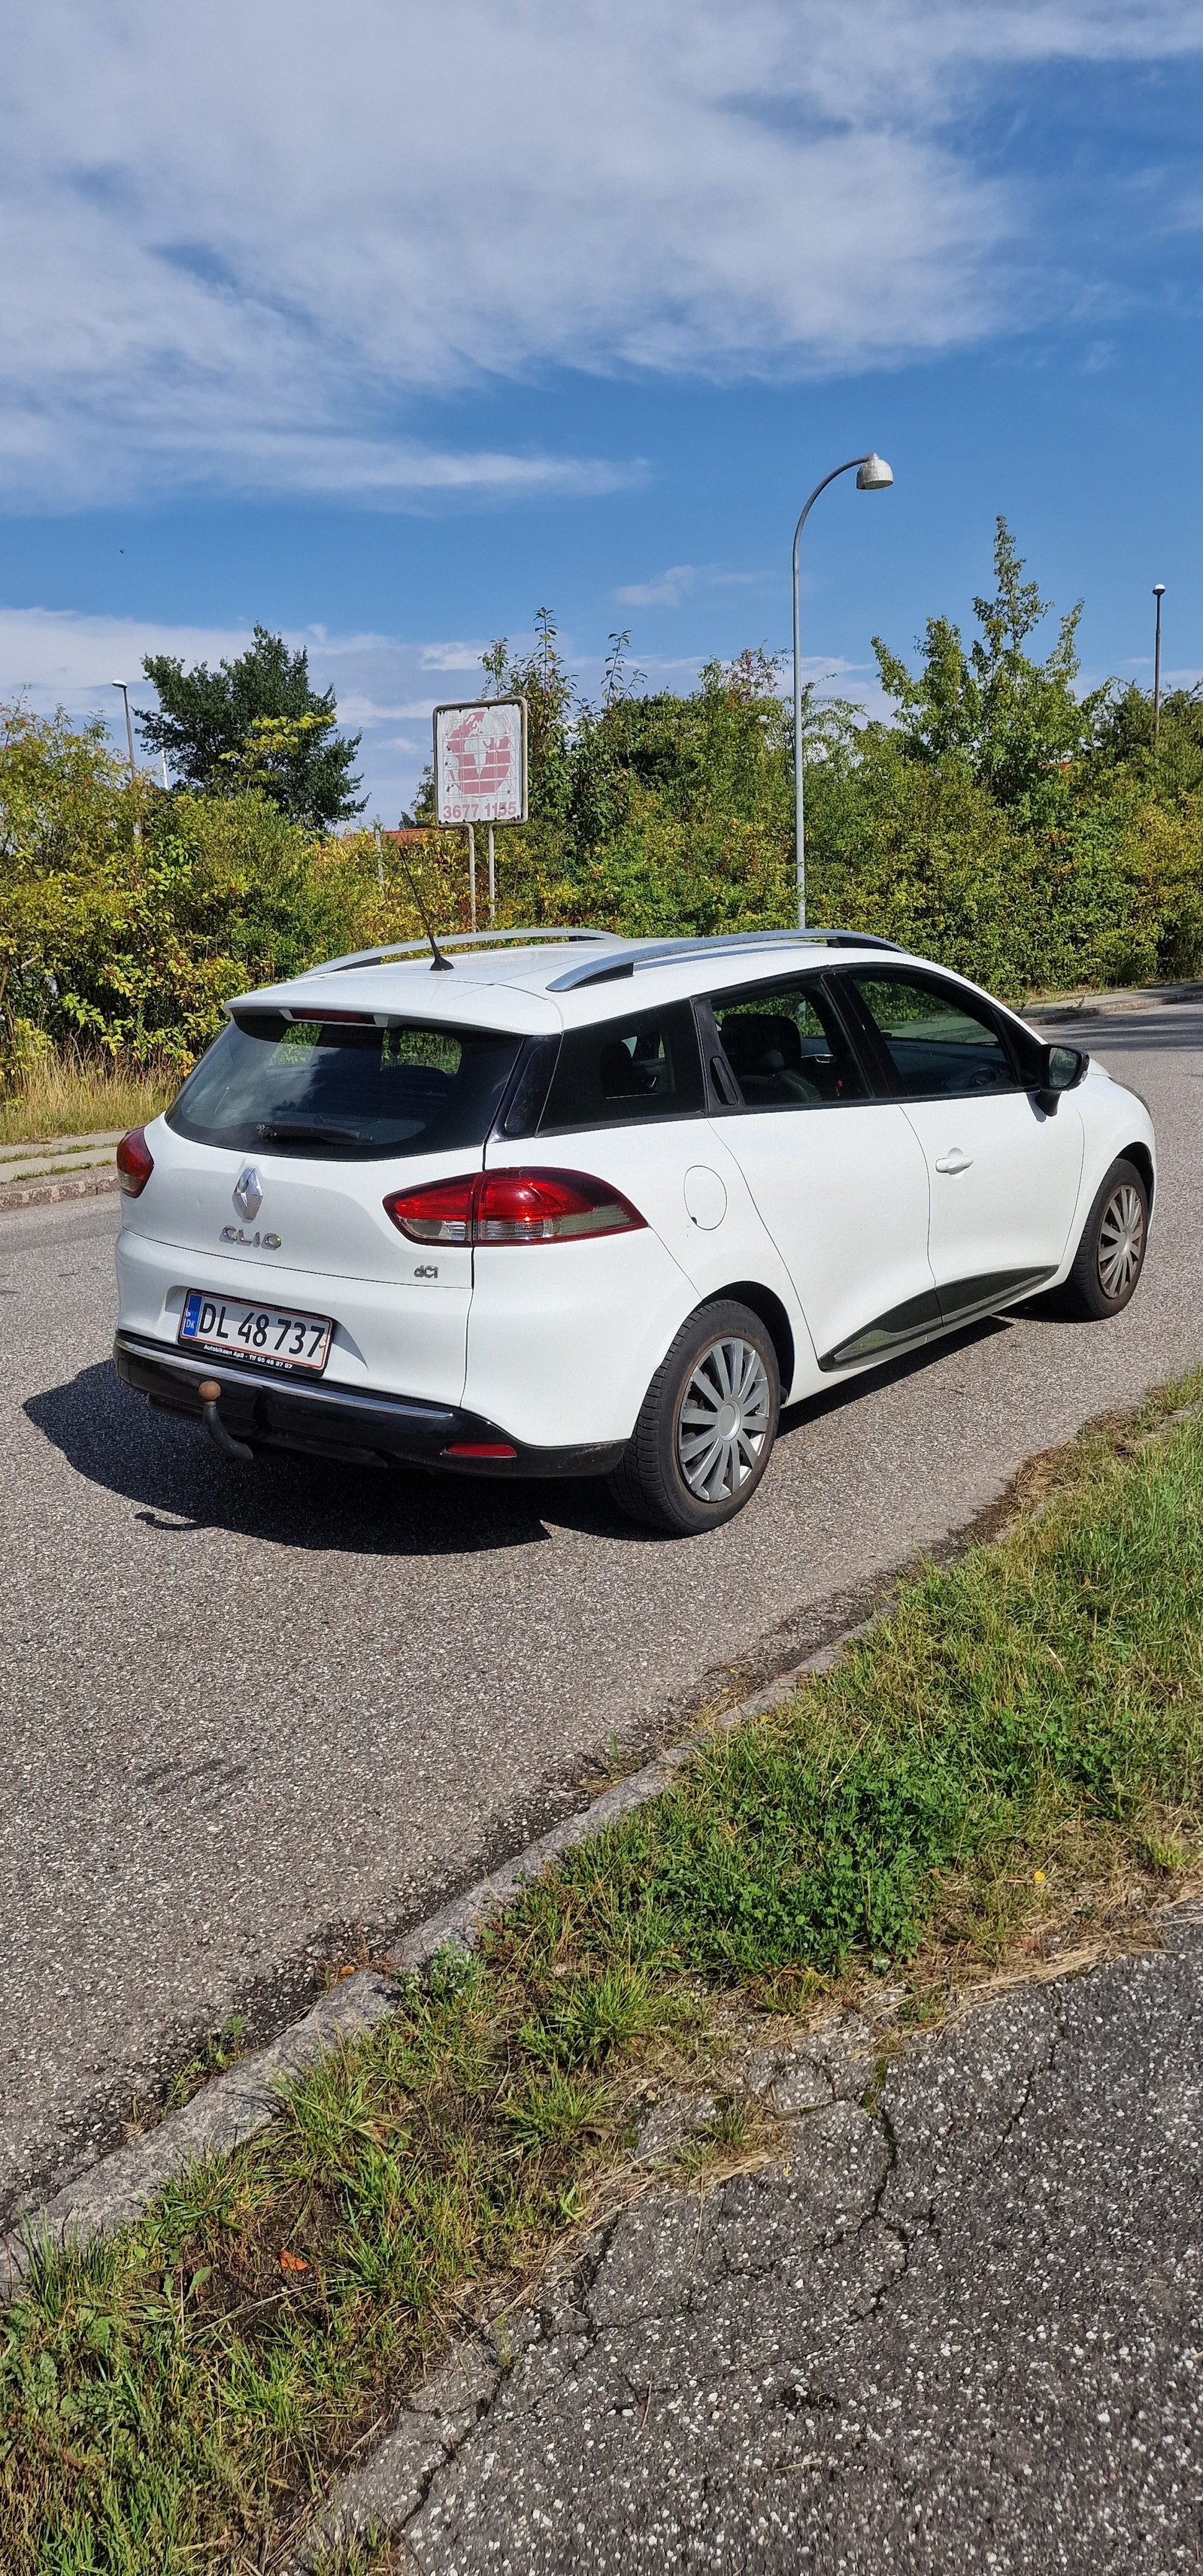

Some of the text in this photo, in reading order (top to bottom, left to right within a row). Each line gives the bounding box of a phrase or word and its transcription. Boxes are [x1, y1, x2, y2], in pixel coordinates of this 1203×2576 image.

[443, 802, 517, 819] 3677 1155
[220, 1226, 281, 1250] CLIO
[186, 1319, 195, 1329] DK
[199, 1302, 325, 1357] DL 48 737
